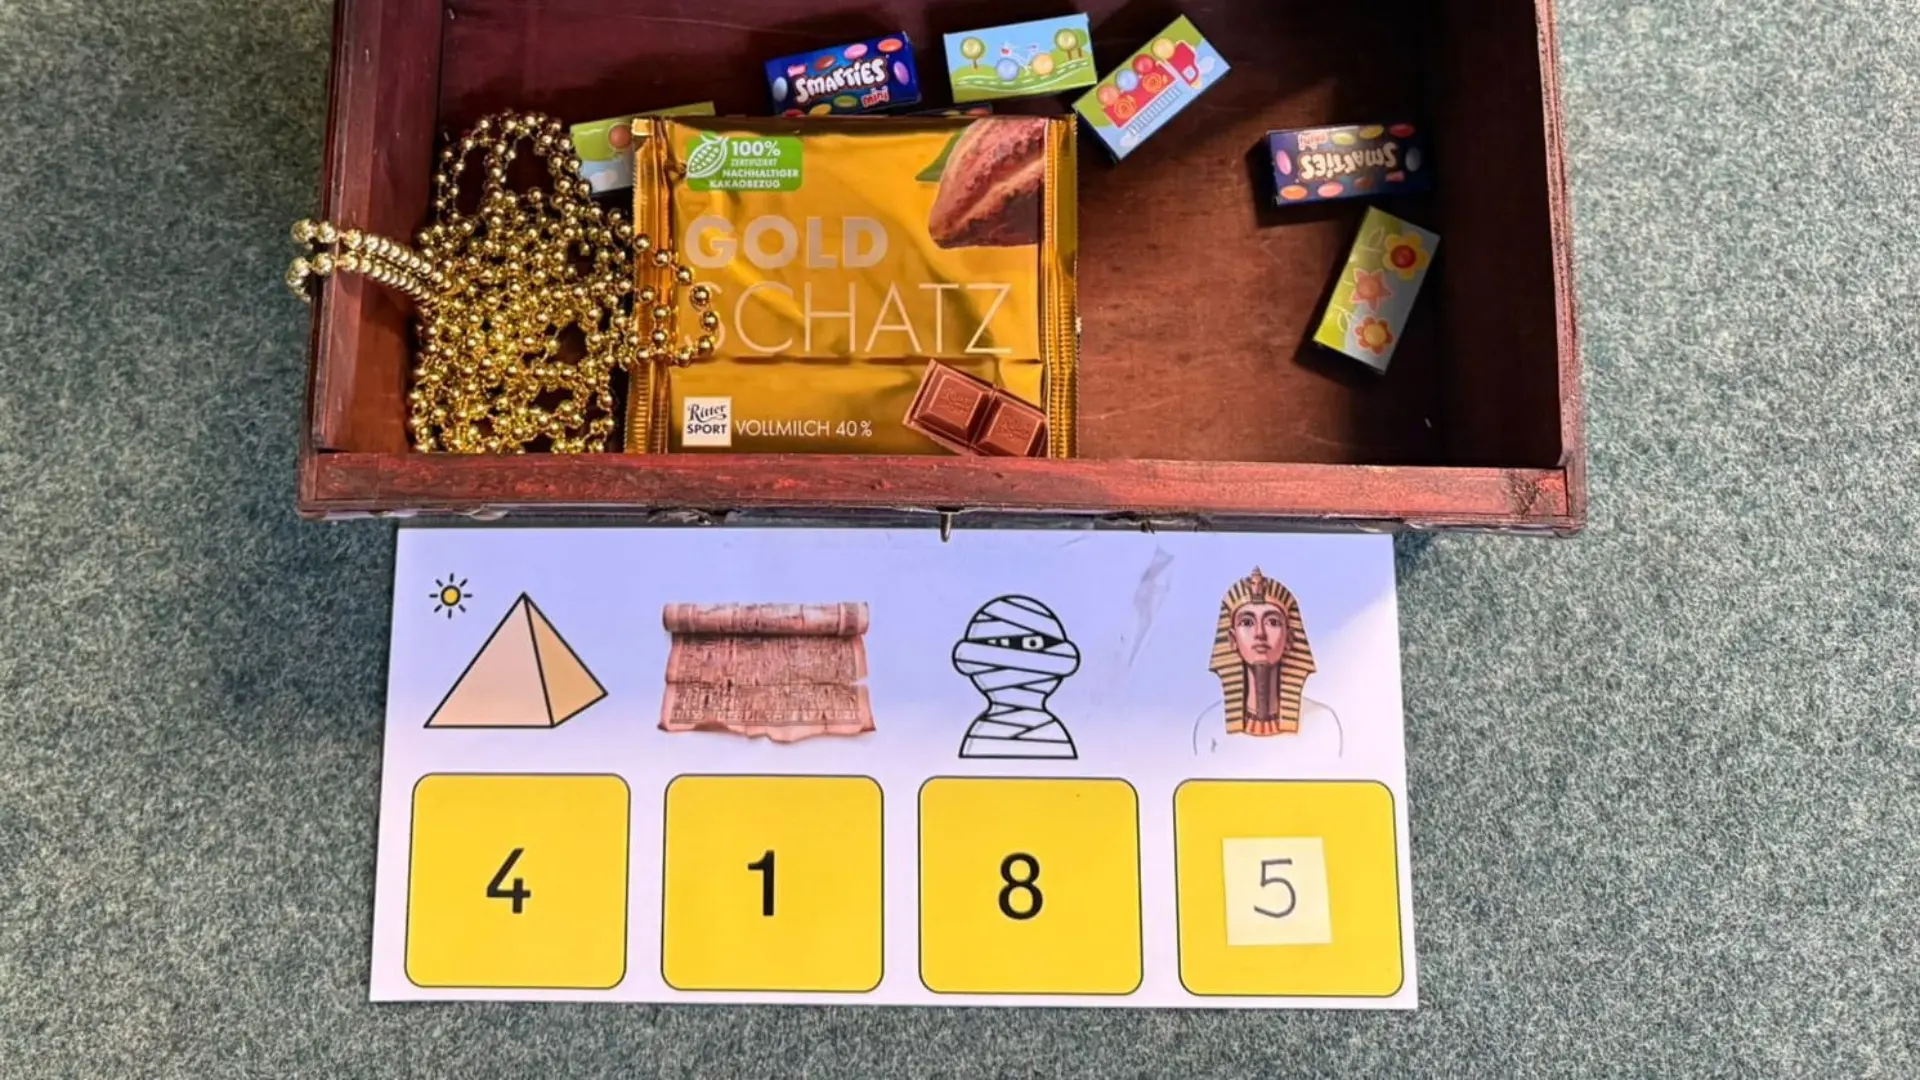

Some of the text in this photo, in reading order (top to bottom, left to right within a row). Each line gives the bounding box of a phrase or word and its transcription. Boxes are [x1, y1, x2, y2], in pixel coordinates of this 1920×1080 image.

[795, 58, 886, 102] SMARTIES
[861, 86, 889, 107] mini
[732, 140, 781, 156] 100%
[1301, 142, 1398, 179] SMARTIES
[723, 169, 798, 177] NACHHALTIGER
[685, 215, 888, 269] GOLD
[687, 424, 727, 434] SPORT
[688, 404, 727, 423] Ritter
[735, 420, 830, 436] VOLLMILCH
[486, 847, 531, 914] 4
[747, 850, 776, 917] 1
[998, 852, 1043, 921] 8
[1254, 859, 1296, 918] 5
